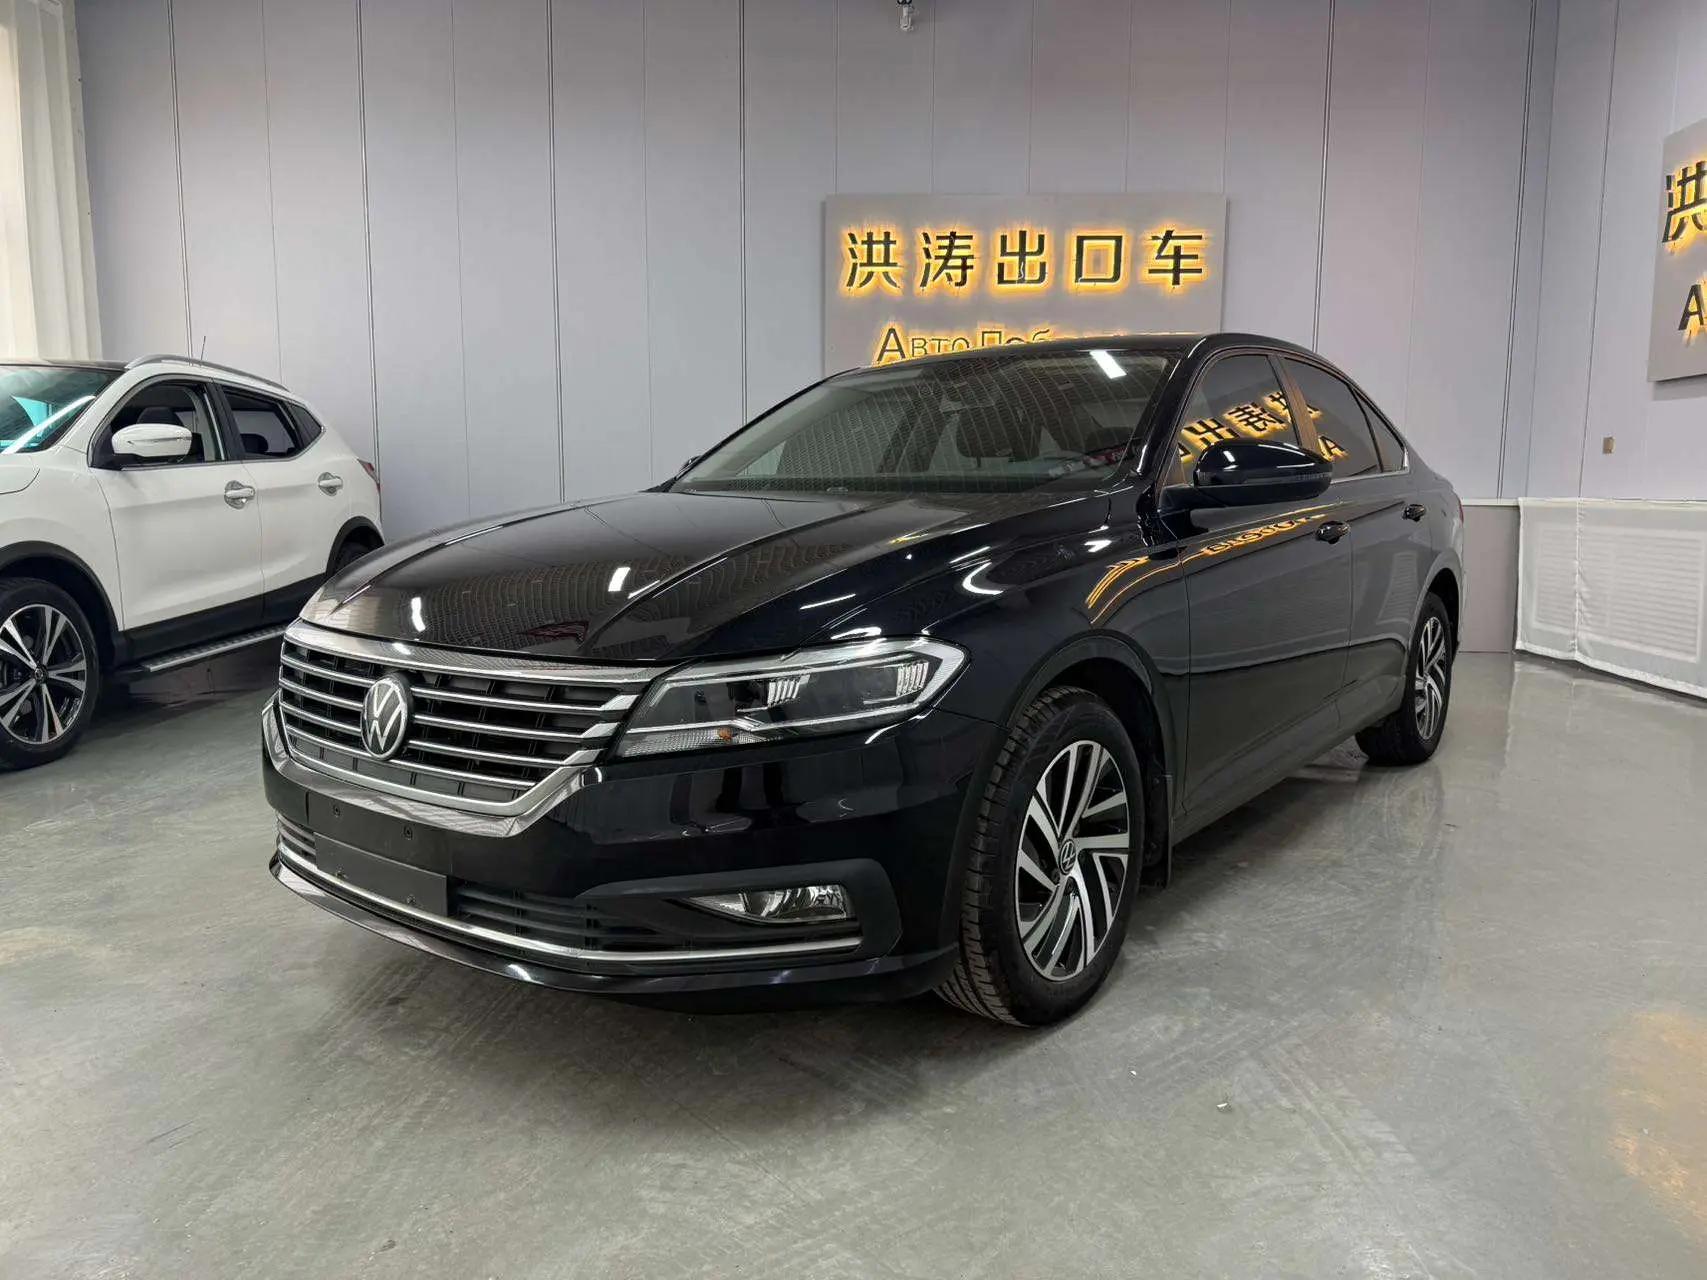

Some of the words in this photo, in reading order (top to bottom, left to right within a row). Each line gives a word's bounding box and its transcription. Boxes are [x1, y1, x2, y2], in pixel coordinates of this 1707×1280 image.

[846, 230, 1204, 288] 洪涛出口车
